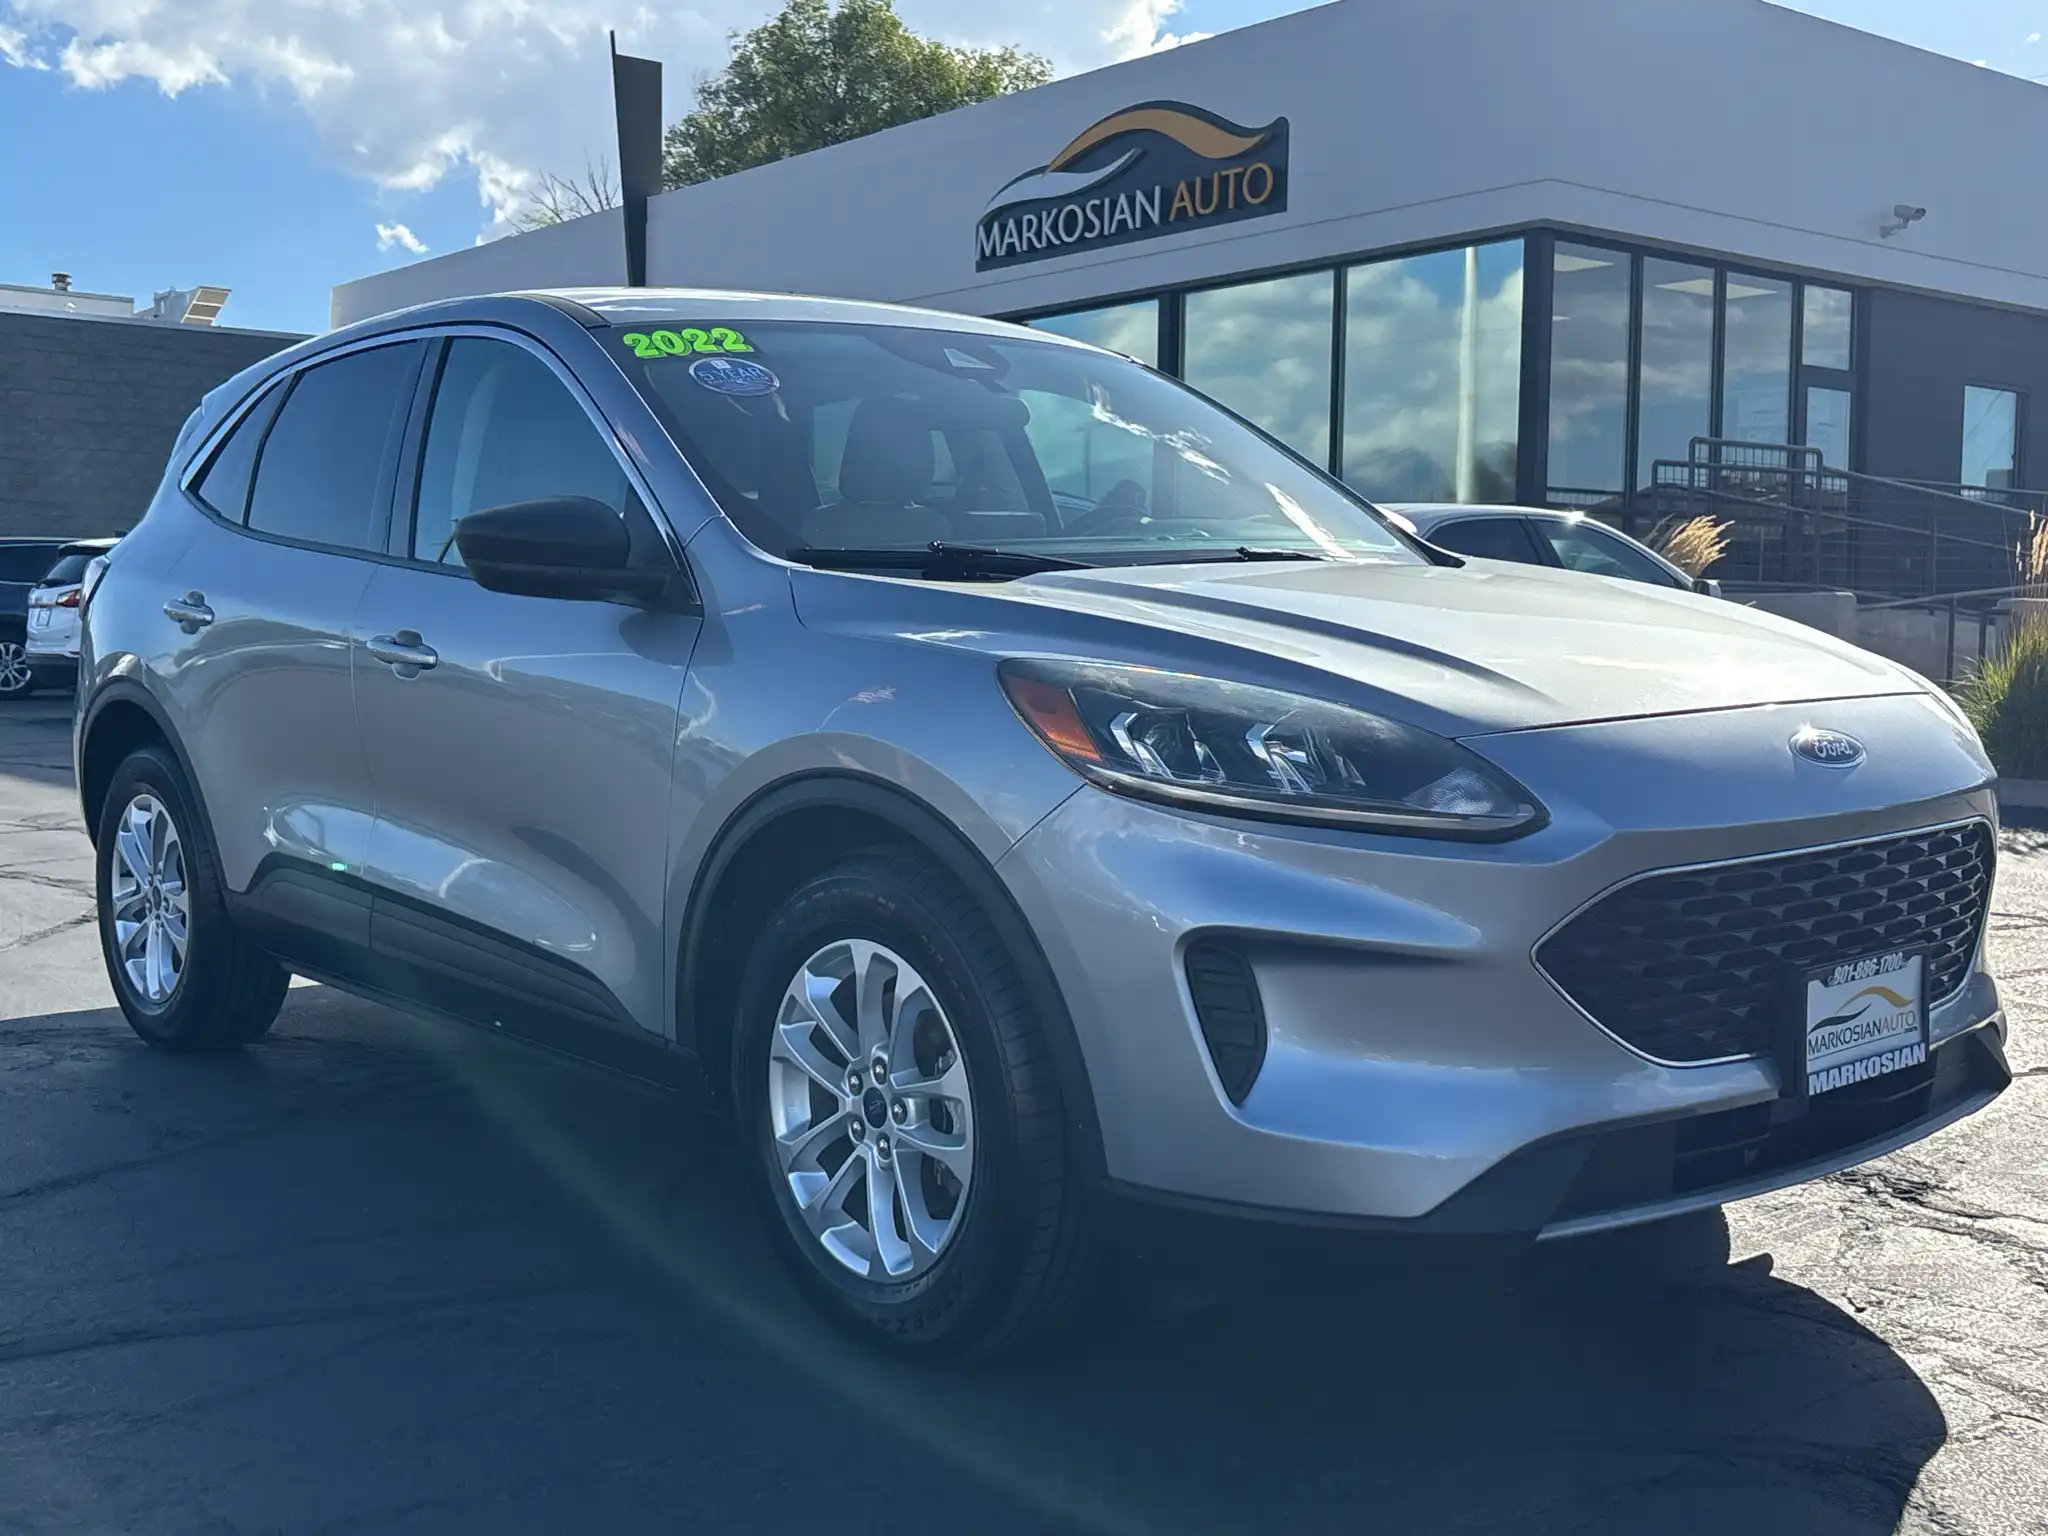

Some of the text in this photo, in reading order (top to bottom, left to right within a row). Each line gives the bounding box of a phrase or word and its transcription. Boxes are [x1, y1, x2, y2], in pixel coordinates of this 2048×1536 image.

[975, 162, 1273, 261] MARKOSIAN AUTO
[623, 327, 754, 359] 2022
[697, 371, 714, 381] 5
[712, 367, 765, 381] YEAR
[1812, 735, 1853, 758] Ford
[1808, 1043, 1926, 1096] MARKOSIAN
